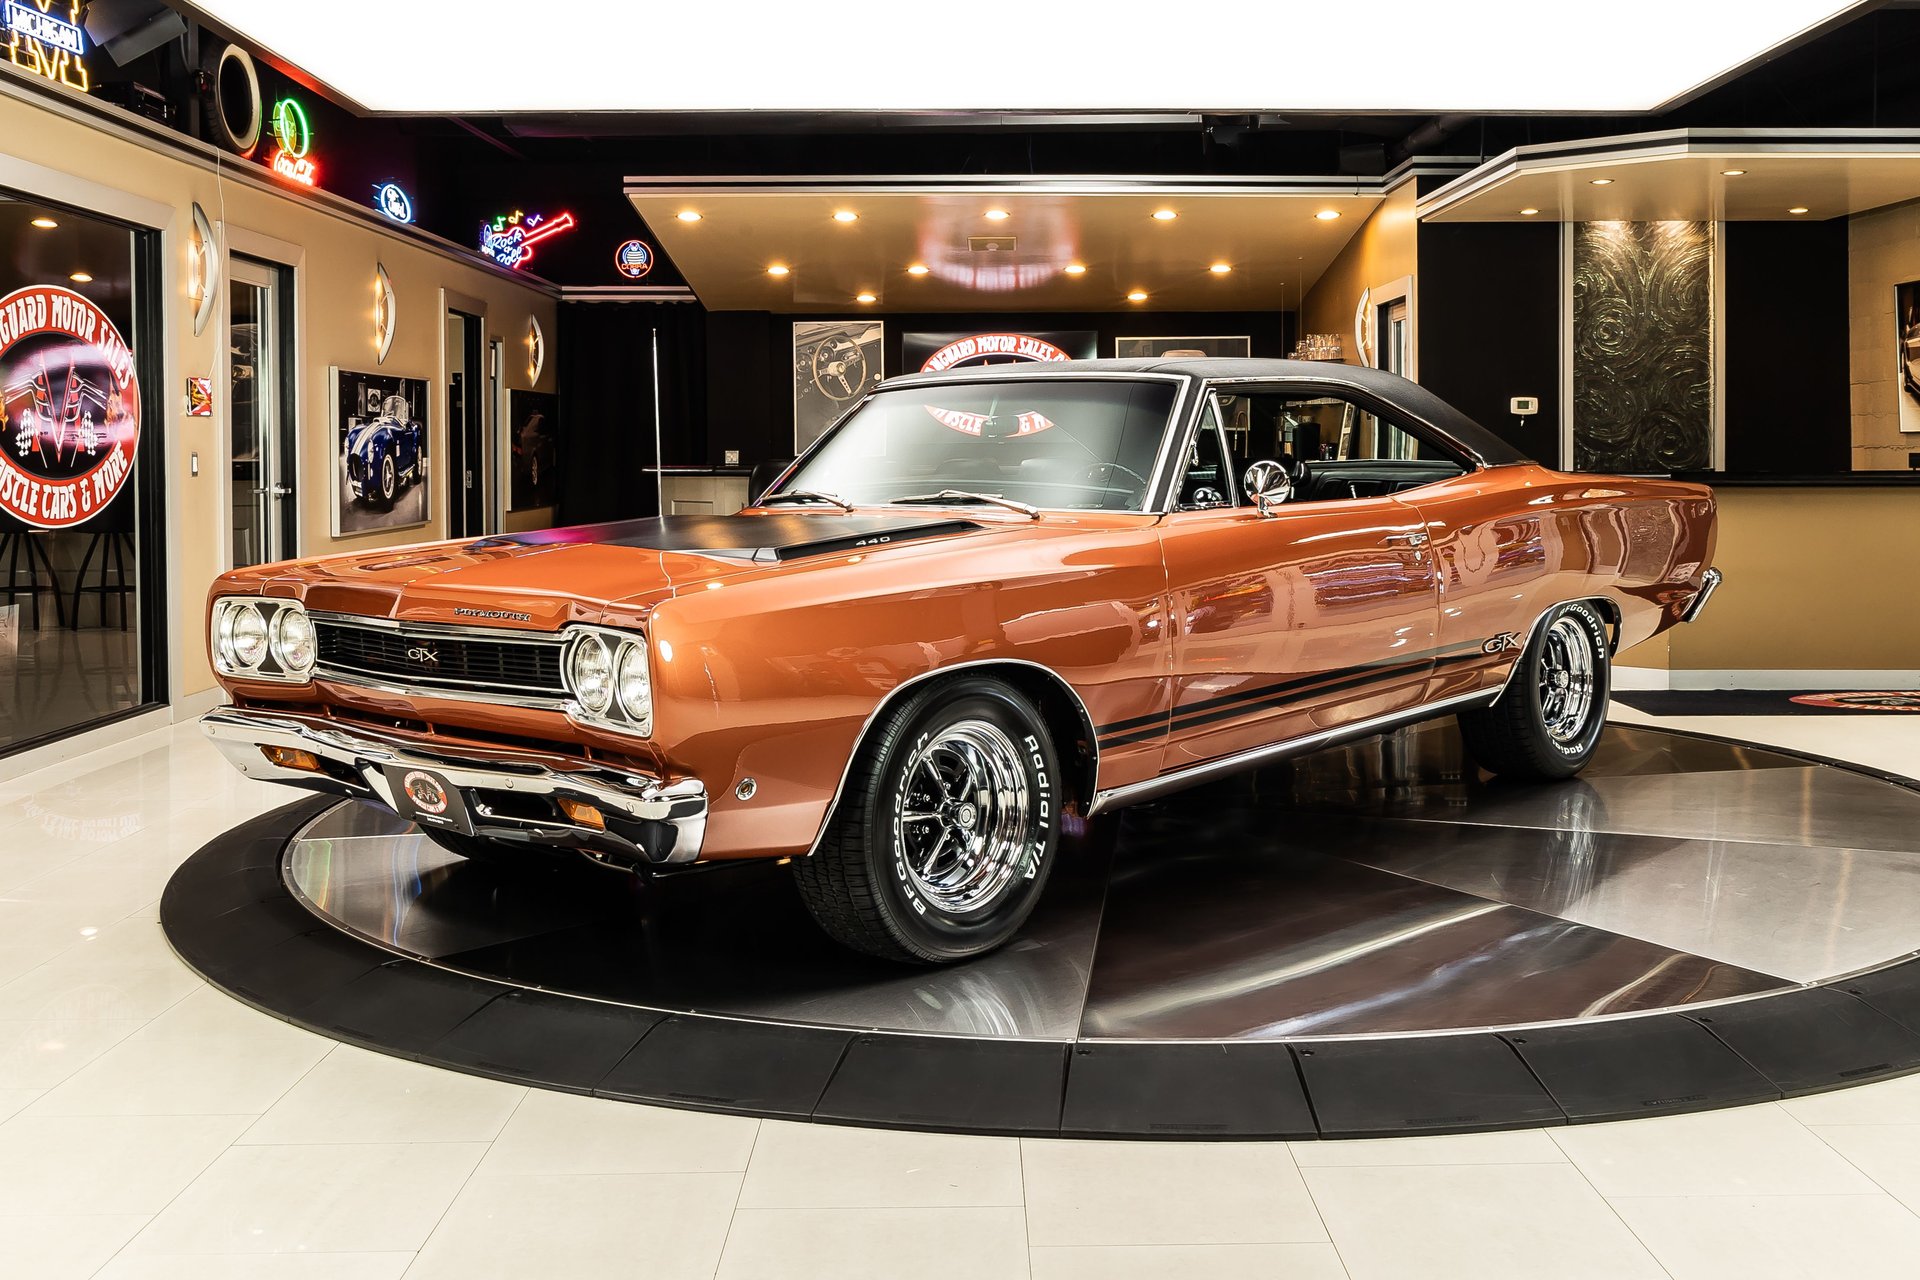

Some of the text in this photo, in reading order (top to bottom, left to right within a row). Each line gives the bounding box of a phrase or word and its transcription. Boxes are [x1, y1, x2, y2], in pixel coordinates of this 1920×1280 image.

[11, 6, 78, 50] MICHIGAN
[492, 228, 522, 249] Rock
[0, 294, 134, 390] GUARD MOTOR SALES
[976, 335, 1018, 353] MOTOR
[41, 484, 77, 519] CARS
[80, 478, 91, 512] &
[91, 440, 128, 505] MORE
[855, 536, 891, 546] 440
[454, 607, 532, 622] PLYMOUTH
[1481, 631, 1522, 654] GTX
[407, 647, 439, 662] GTX
[1023, 734, 1050, 880] Radial T/A
[893, 731, 929, 916] BFGoodrich
